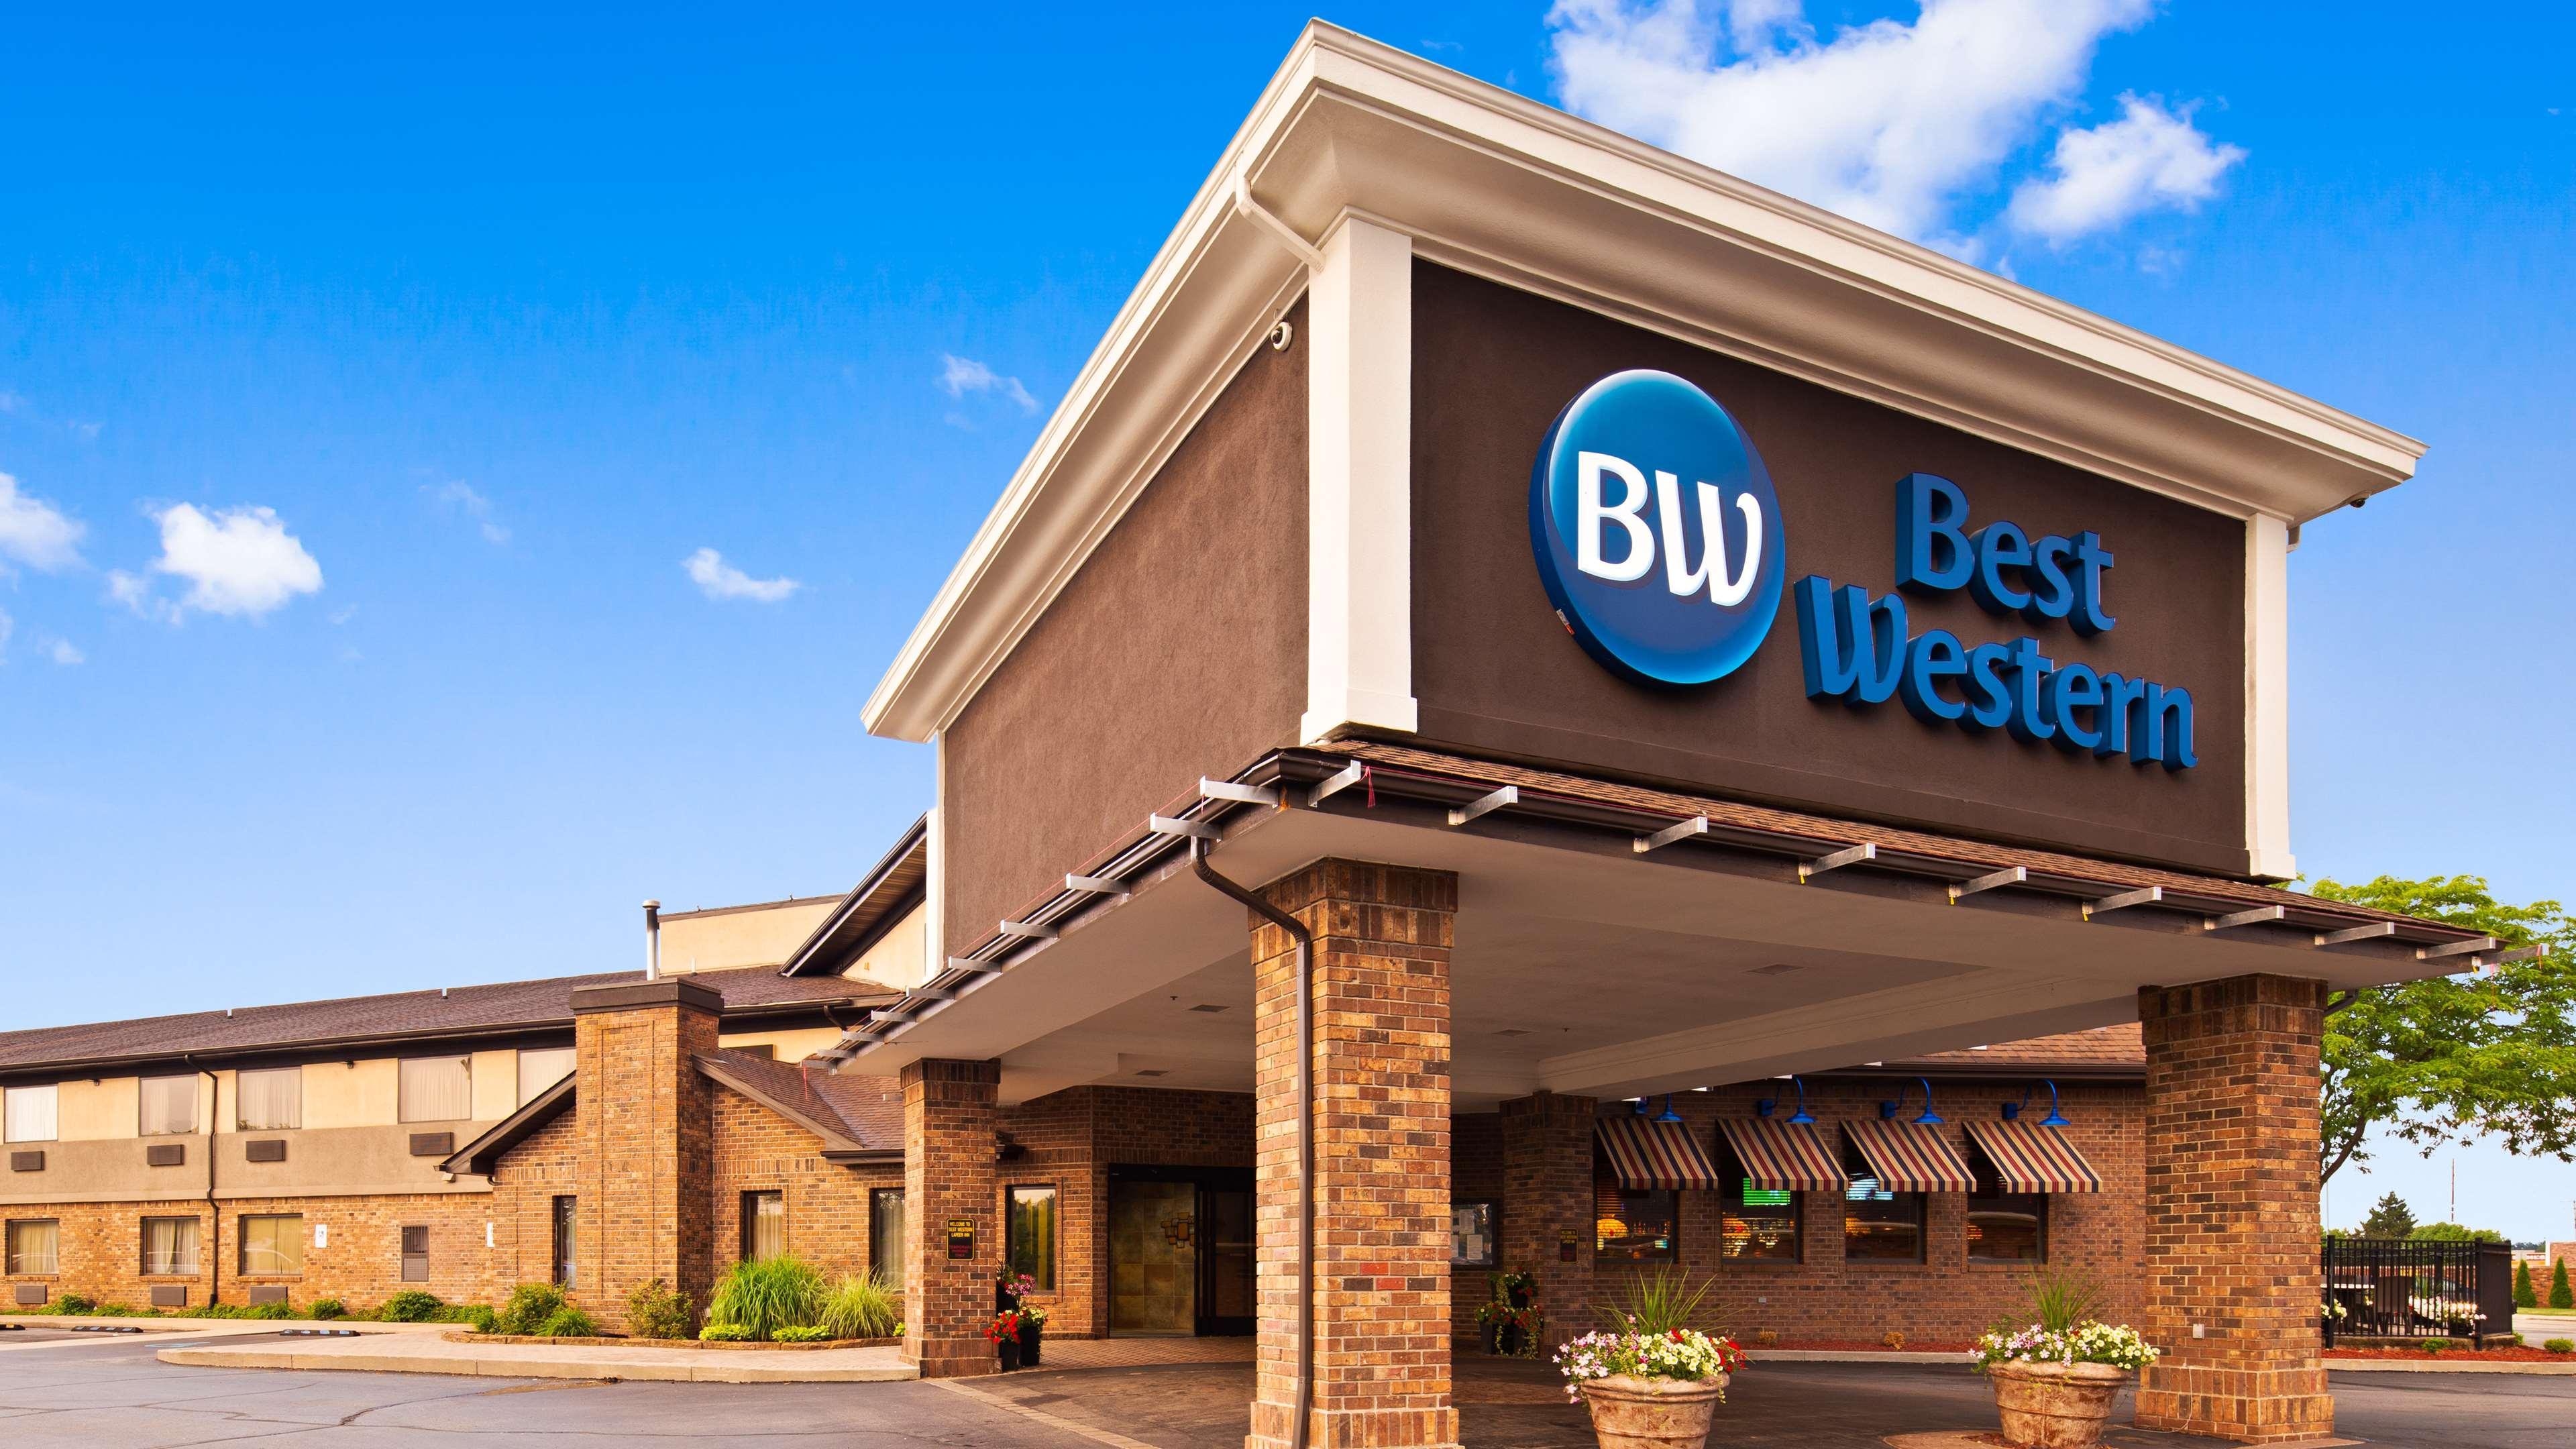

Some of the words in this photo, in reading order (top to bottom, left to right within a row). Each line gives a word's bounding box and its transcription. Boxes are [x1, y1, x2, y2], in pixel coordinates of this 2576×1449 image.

[1578, 451, 1762, 606] BW
[1895, 472, 2116, 632] Best
[1794, 574, 2198, 769] Western
